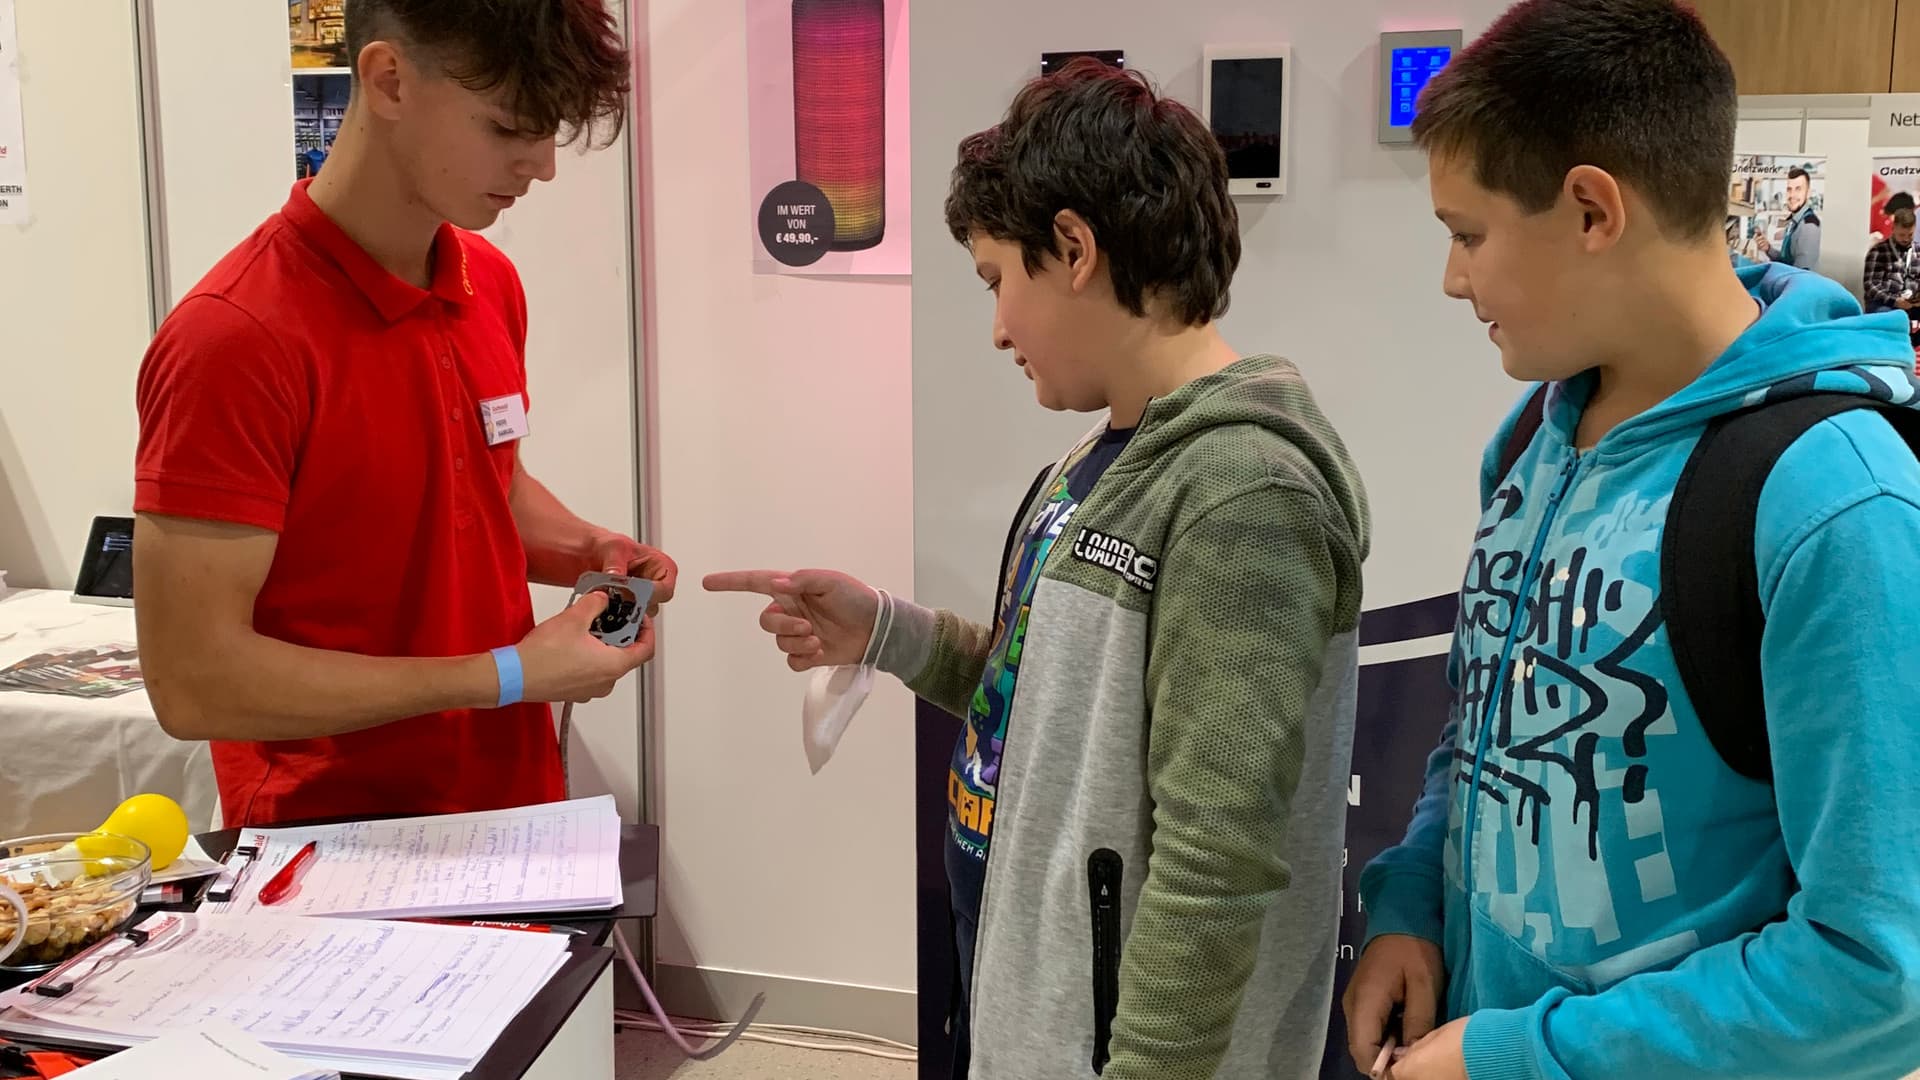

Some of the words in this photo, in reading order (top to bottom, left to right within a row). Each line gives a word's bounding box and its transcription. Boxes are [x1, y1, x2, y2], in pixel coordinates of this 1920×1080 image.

[777, 205, 788, 215] IM
[790, 205, 816, 215] WERT
[787, 219, 807, 229] VON
